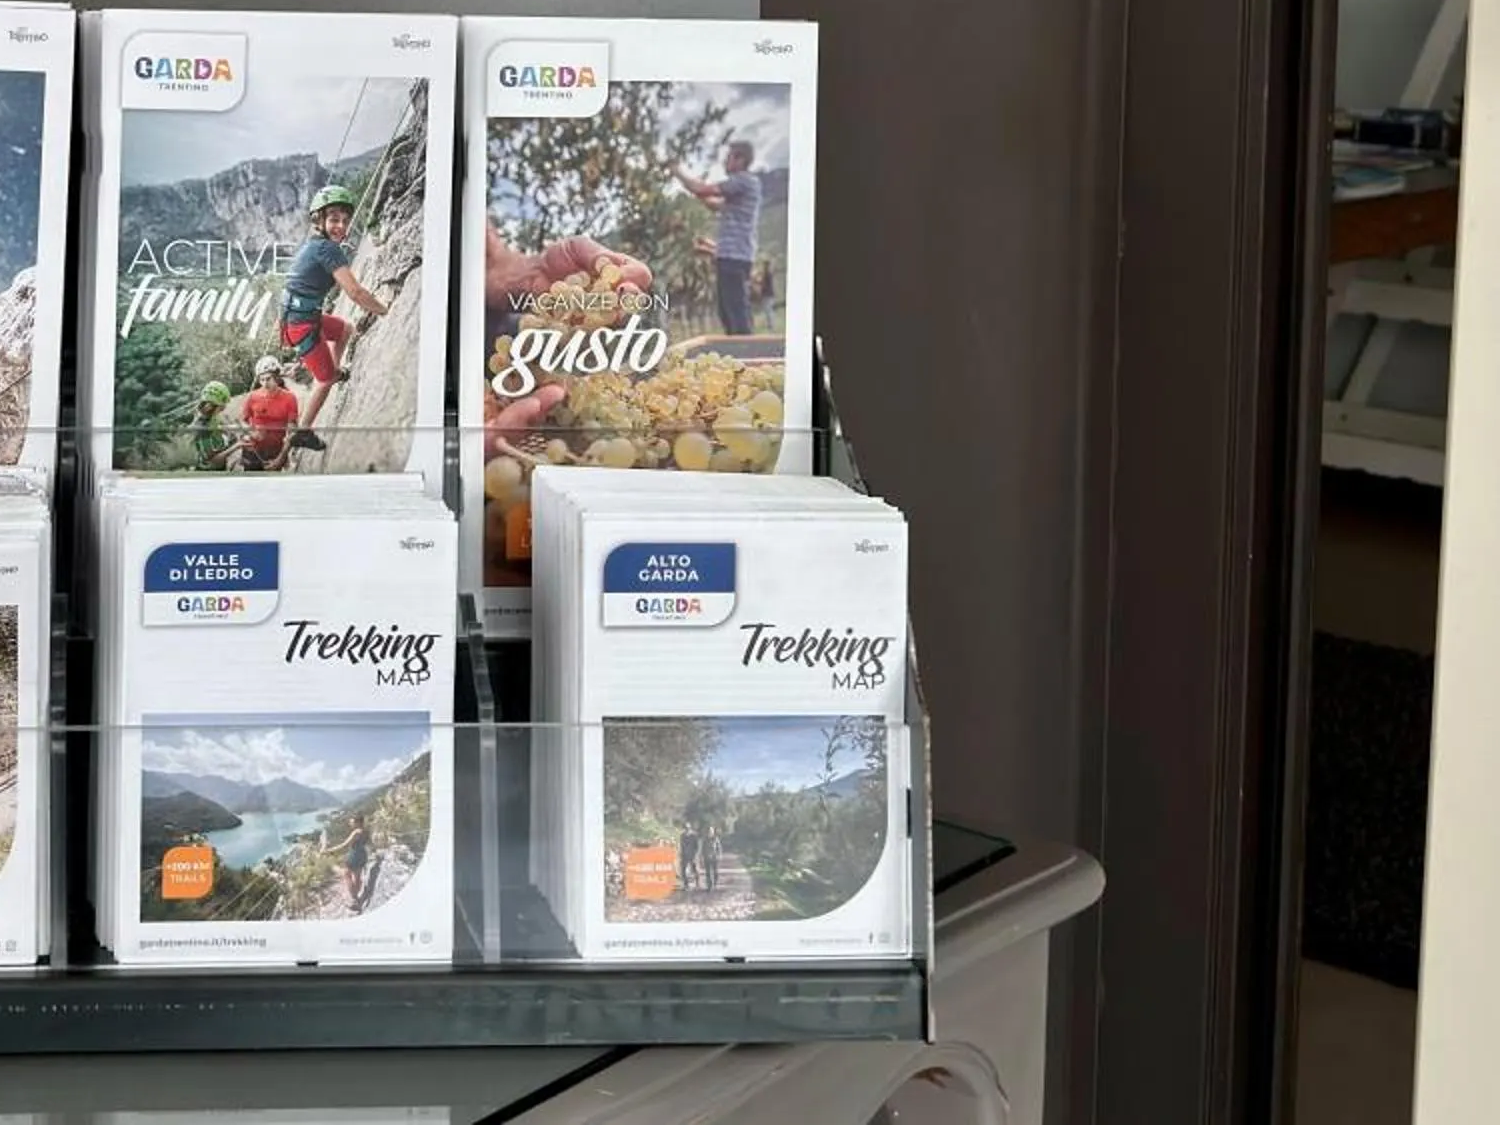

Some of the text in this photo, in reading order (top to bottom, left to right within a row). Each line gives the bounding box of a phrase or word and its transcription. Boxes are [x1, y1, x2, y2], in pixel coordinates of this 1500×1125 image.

[134, 56, 234, 82] GARDA
[499, 65, 597, 89] GARDA
[159, 83, 209, 92] TRENTINO
[523, 90, 574, 100] TRENTINO
[127, 238, 298, 276] ACTIVE
[120, 274, 273, 340] family
[507, 292, 669, 313] VACANZE CON
[491, 313, 670, 397] gusto
[184, 554, 240, 567] VALLE
[647, 555, 691, 568] ALTO
[169, 567, 254, 581] DI LEDRO
[638, 568, 700, 582] GARDA
[177, 596, 245, 612] GARDA
[635, 597, 702, 614] GARDA
[283, 619, 442, 673] Trekking
[739, 622, 897, 677] Trekking
[376, 668, 432, 687] MAP
[831, 672, 886, 690] MAP
